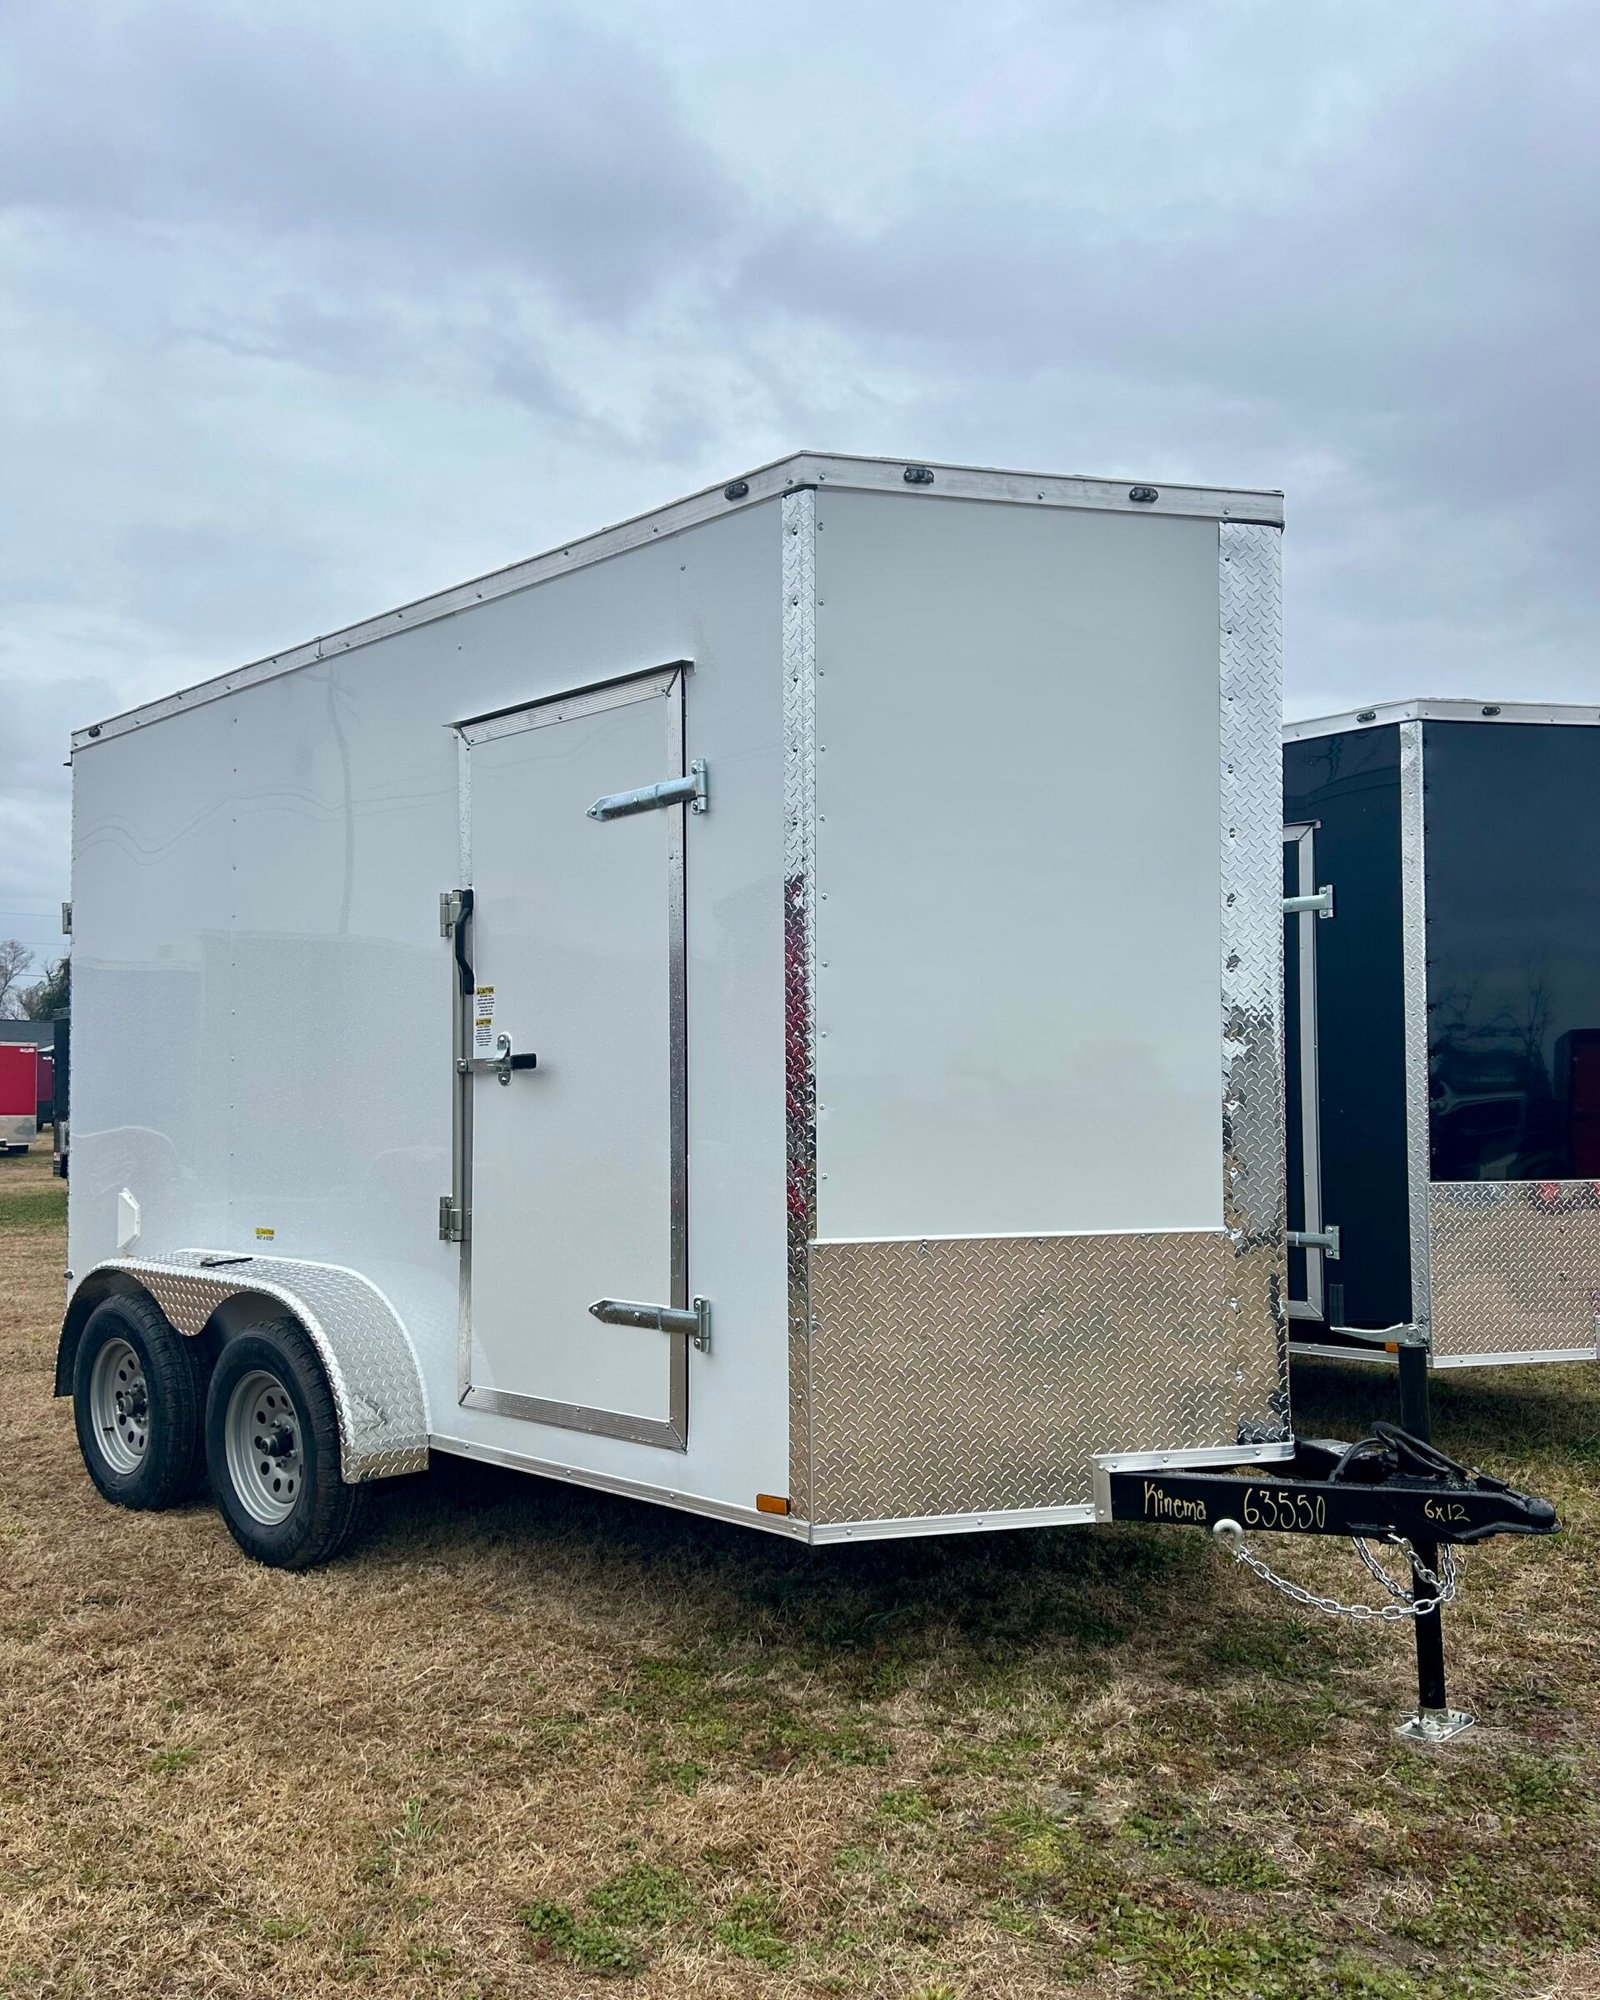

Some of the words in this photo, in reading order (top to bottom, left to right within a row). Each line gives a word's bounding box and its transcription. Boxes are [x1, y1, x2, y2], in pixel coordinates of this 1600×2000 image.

[1144, 1481, 1207, 1521] Kinema
[1243, 1487, 1326, 1529] 63550
[1424, 1499, 1471, 1523] 6x12
